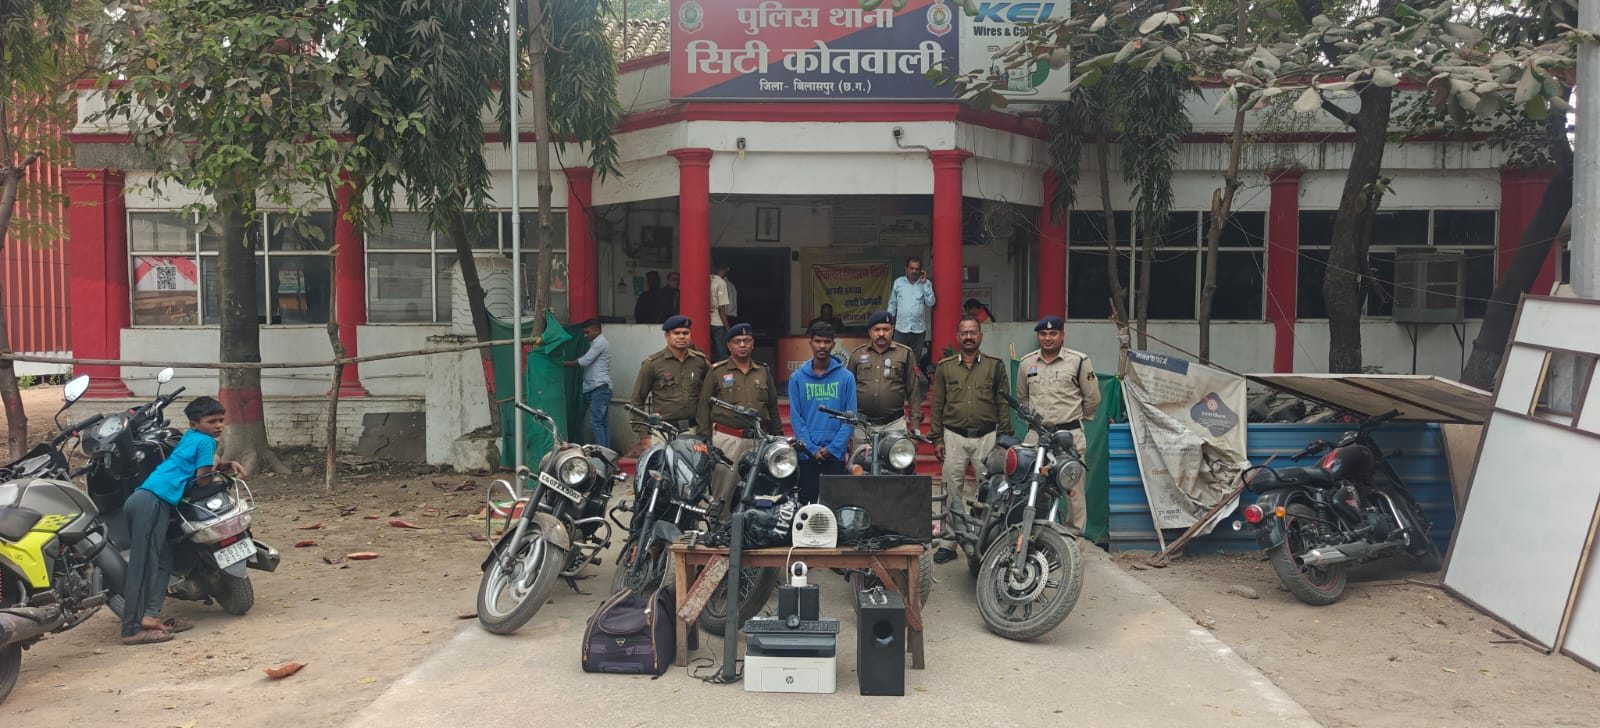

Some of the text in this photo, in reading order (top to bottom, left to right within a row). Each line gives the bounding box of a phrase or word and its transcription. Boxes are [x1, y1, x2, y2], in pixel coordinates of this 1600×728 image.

[736, 1, 893, 35] पुलिस थाना
[973, 3, 1055, 23] KEI
[973, 26, 1002, 37] Wires
[1004, 27, 1011, 37] &
[685, 40, 945, 74] सिटी कोतवाली
[794, 78, 834, 95] बिलासपुर
[838, 79, 872, 94] (छ.ग.)
[805, 382, 839, 400] EVERLAST
